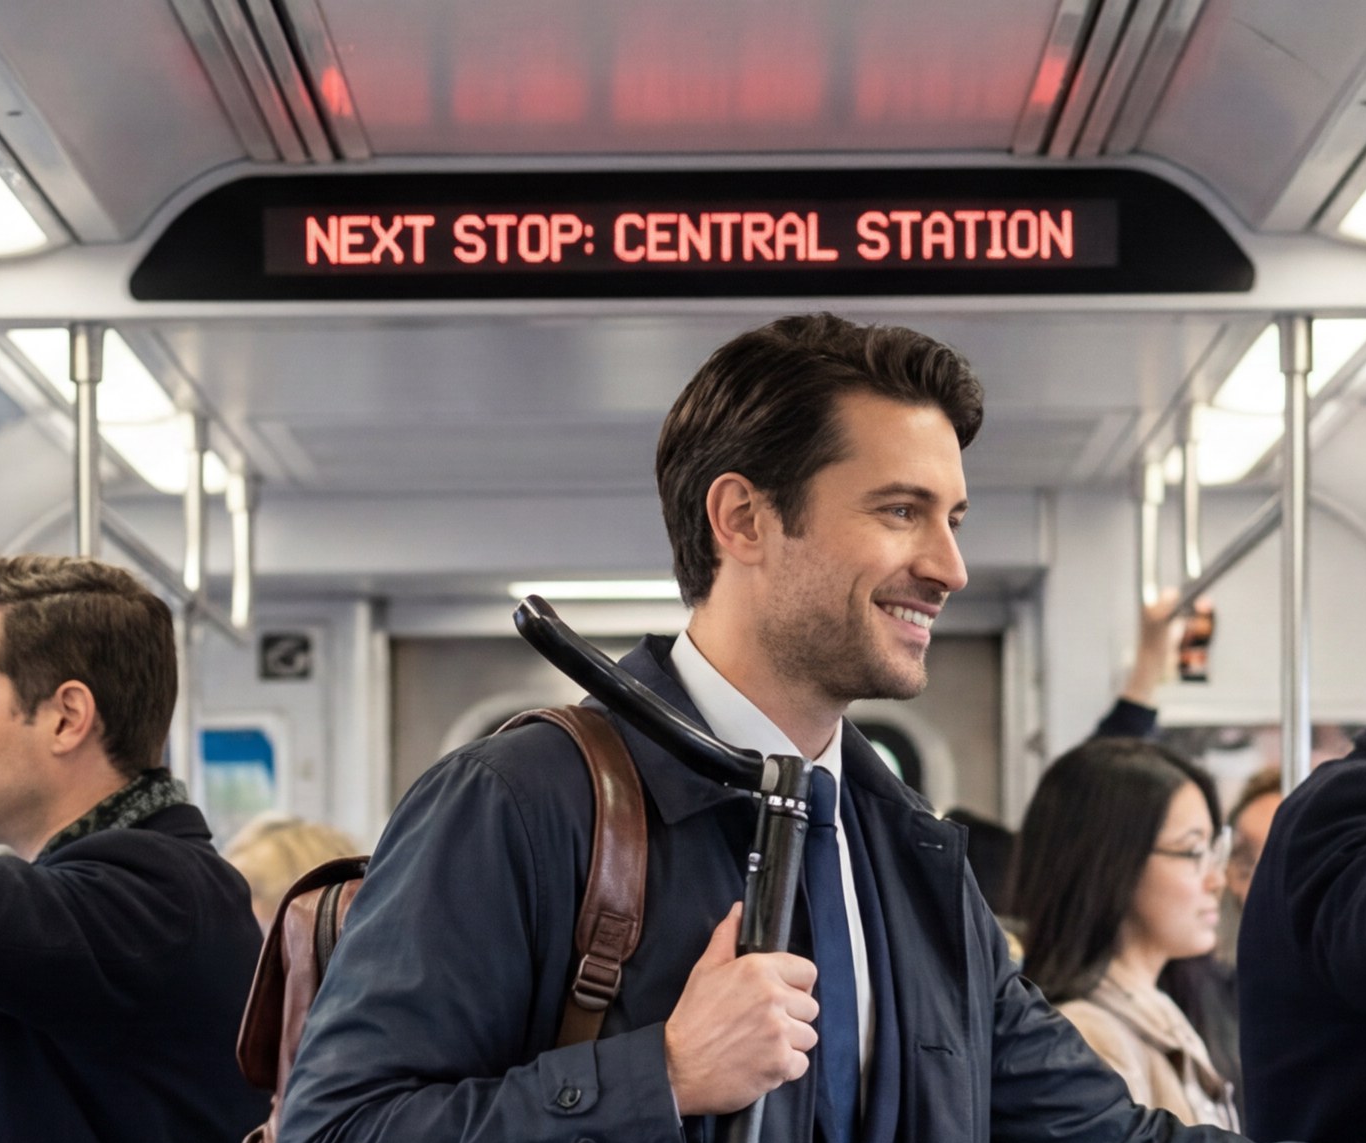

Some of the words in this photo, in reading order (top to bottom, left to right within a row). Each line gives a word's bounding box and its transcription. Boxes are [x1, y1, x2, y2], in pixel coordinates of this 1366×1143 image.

[306, 215, 435, 264] NEXT
[454, 214, 594, 263] STOP:
[614, 212, 838, 262] CENTRAL
[857, 210, 1073, 260] STATION
